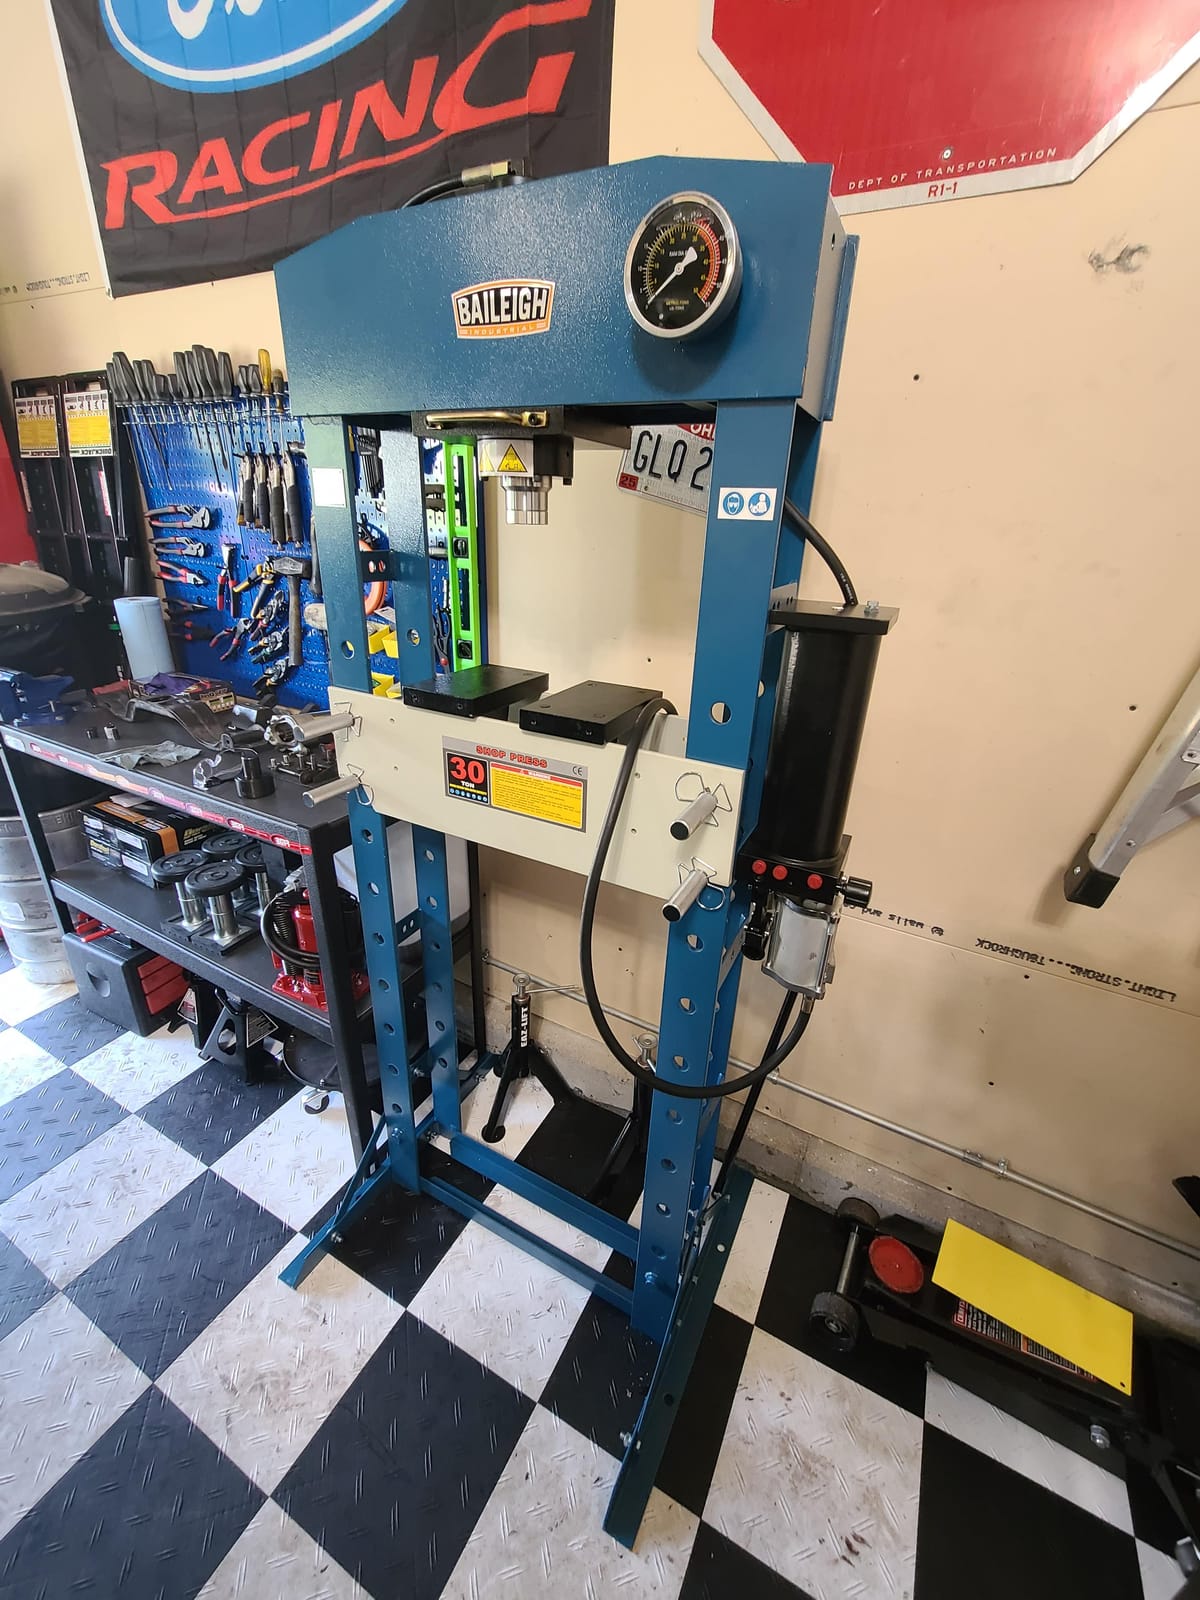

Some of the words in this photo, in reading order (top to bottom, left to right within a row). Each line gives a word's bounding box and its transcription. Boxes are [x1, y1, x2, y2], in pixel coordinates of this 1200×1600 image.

[99, 0, 593, 230] RACING
[848, 176, 883, 191] DEPT
[890, 172, 908, 184] OF
[916, 147, 1057, 179] TRANSPORTATION
[927, 181, 958, 198] R1-1
[457, 287, 548, 325] BAILEIGH
[469, 325, 534, 336] INDUSTRIAL
[690, 423, 714, 440] OH
[80, 448, 112, 456] QUICKJACK
[633, 430, 688, 483] GLQ
[689, 446, 713, 491] 2
[620, 474, 636, 487] 25
[475, 745, 506, 759] SHOP
[509, 752, 548, 769] PRESS
[449, 756, 486, 784] 30
[460, 780, 475, 789] TON
[887, 913, 925, 930] walls
[520, 1006, 528, 1048] EAZ-LIFT
